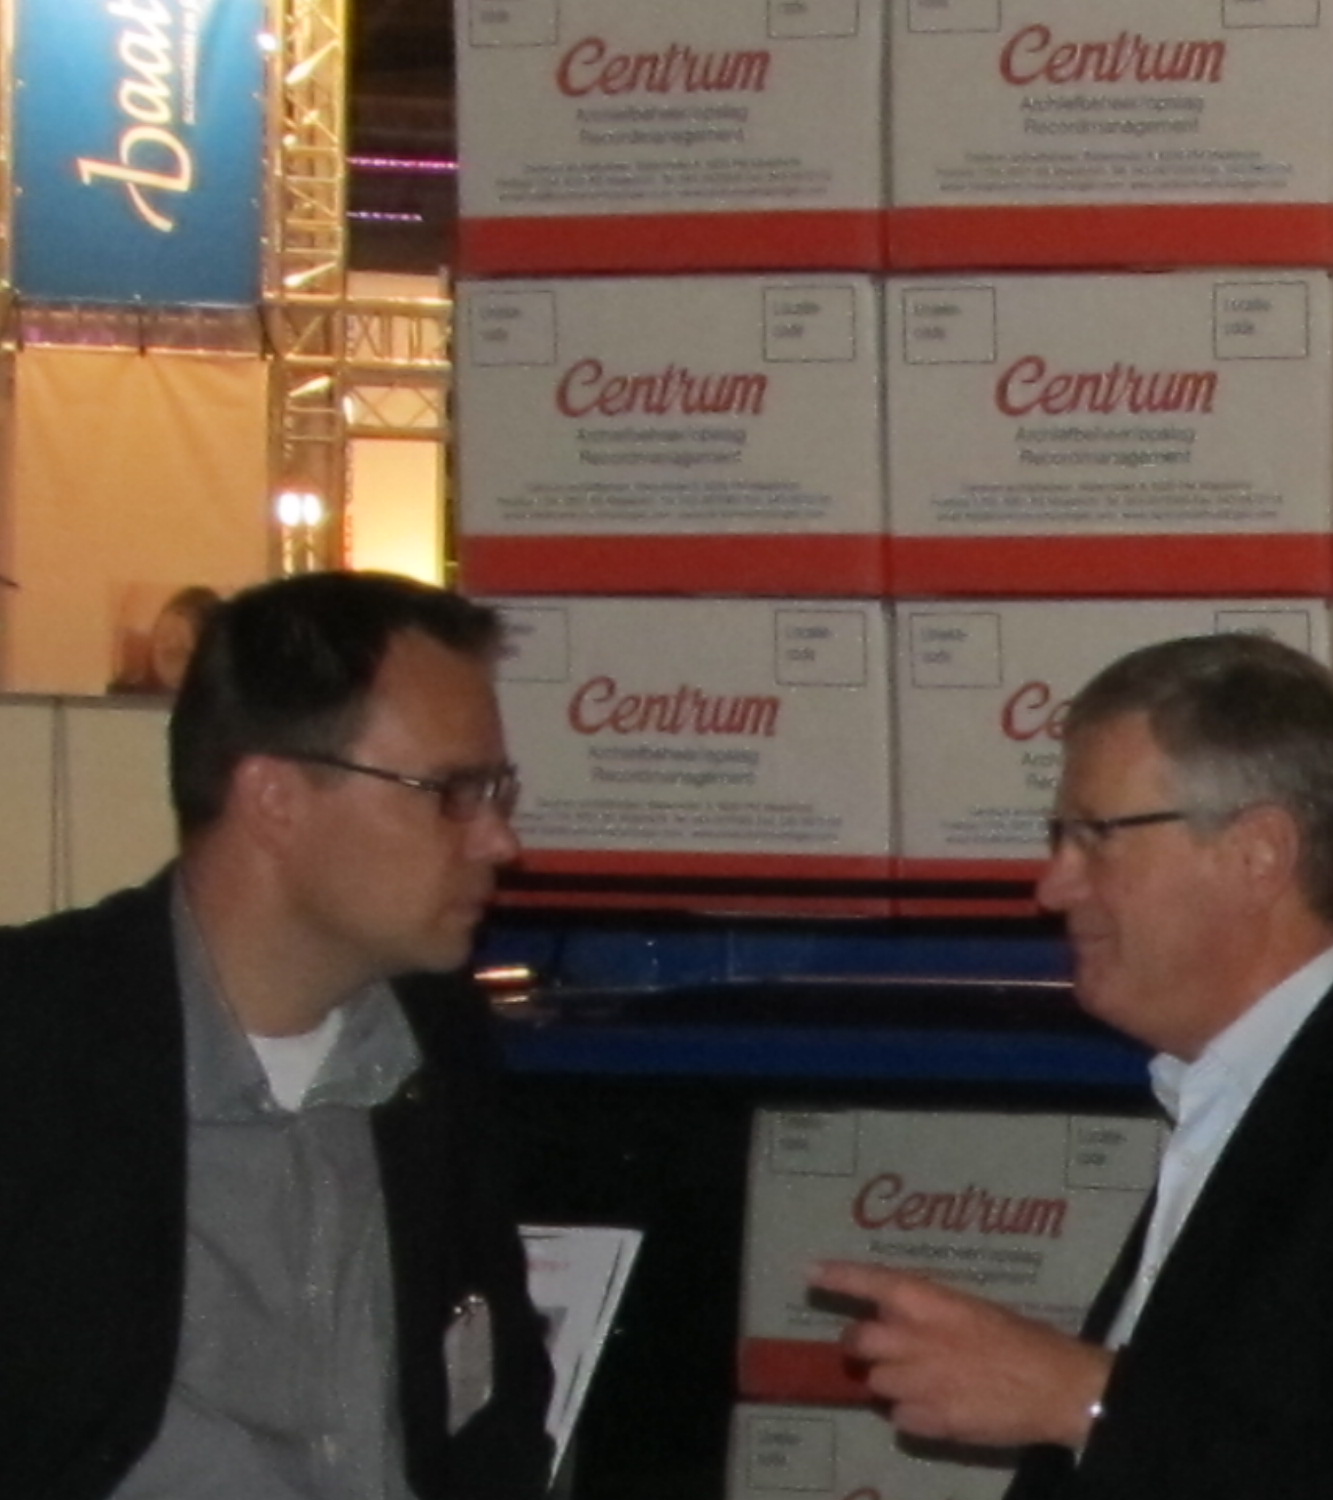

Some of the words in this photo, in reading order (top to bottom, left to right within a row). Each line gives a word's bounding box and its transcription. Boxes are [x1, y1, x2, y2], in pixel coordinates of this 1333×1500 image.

[555, 37, 773, 96] Centrum
[1000, 23, 1226, 86] Centrum
[557, 358, 769, 418] Centrum
[997, 354, 1219, 417] Centrum
[568, 676, 782, 738] Centrum
[852, 1172, 1070, 1240] Centrum
